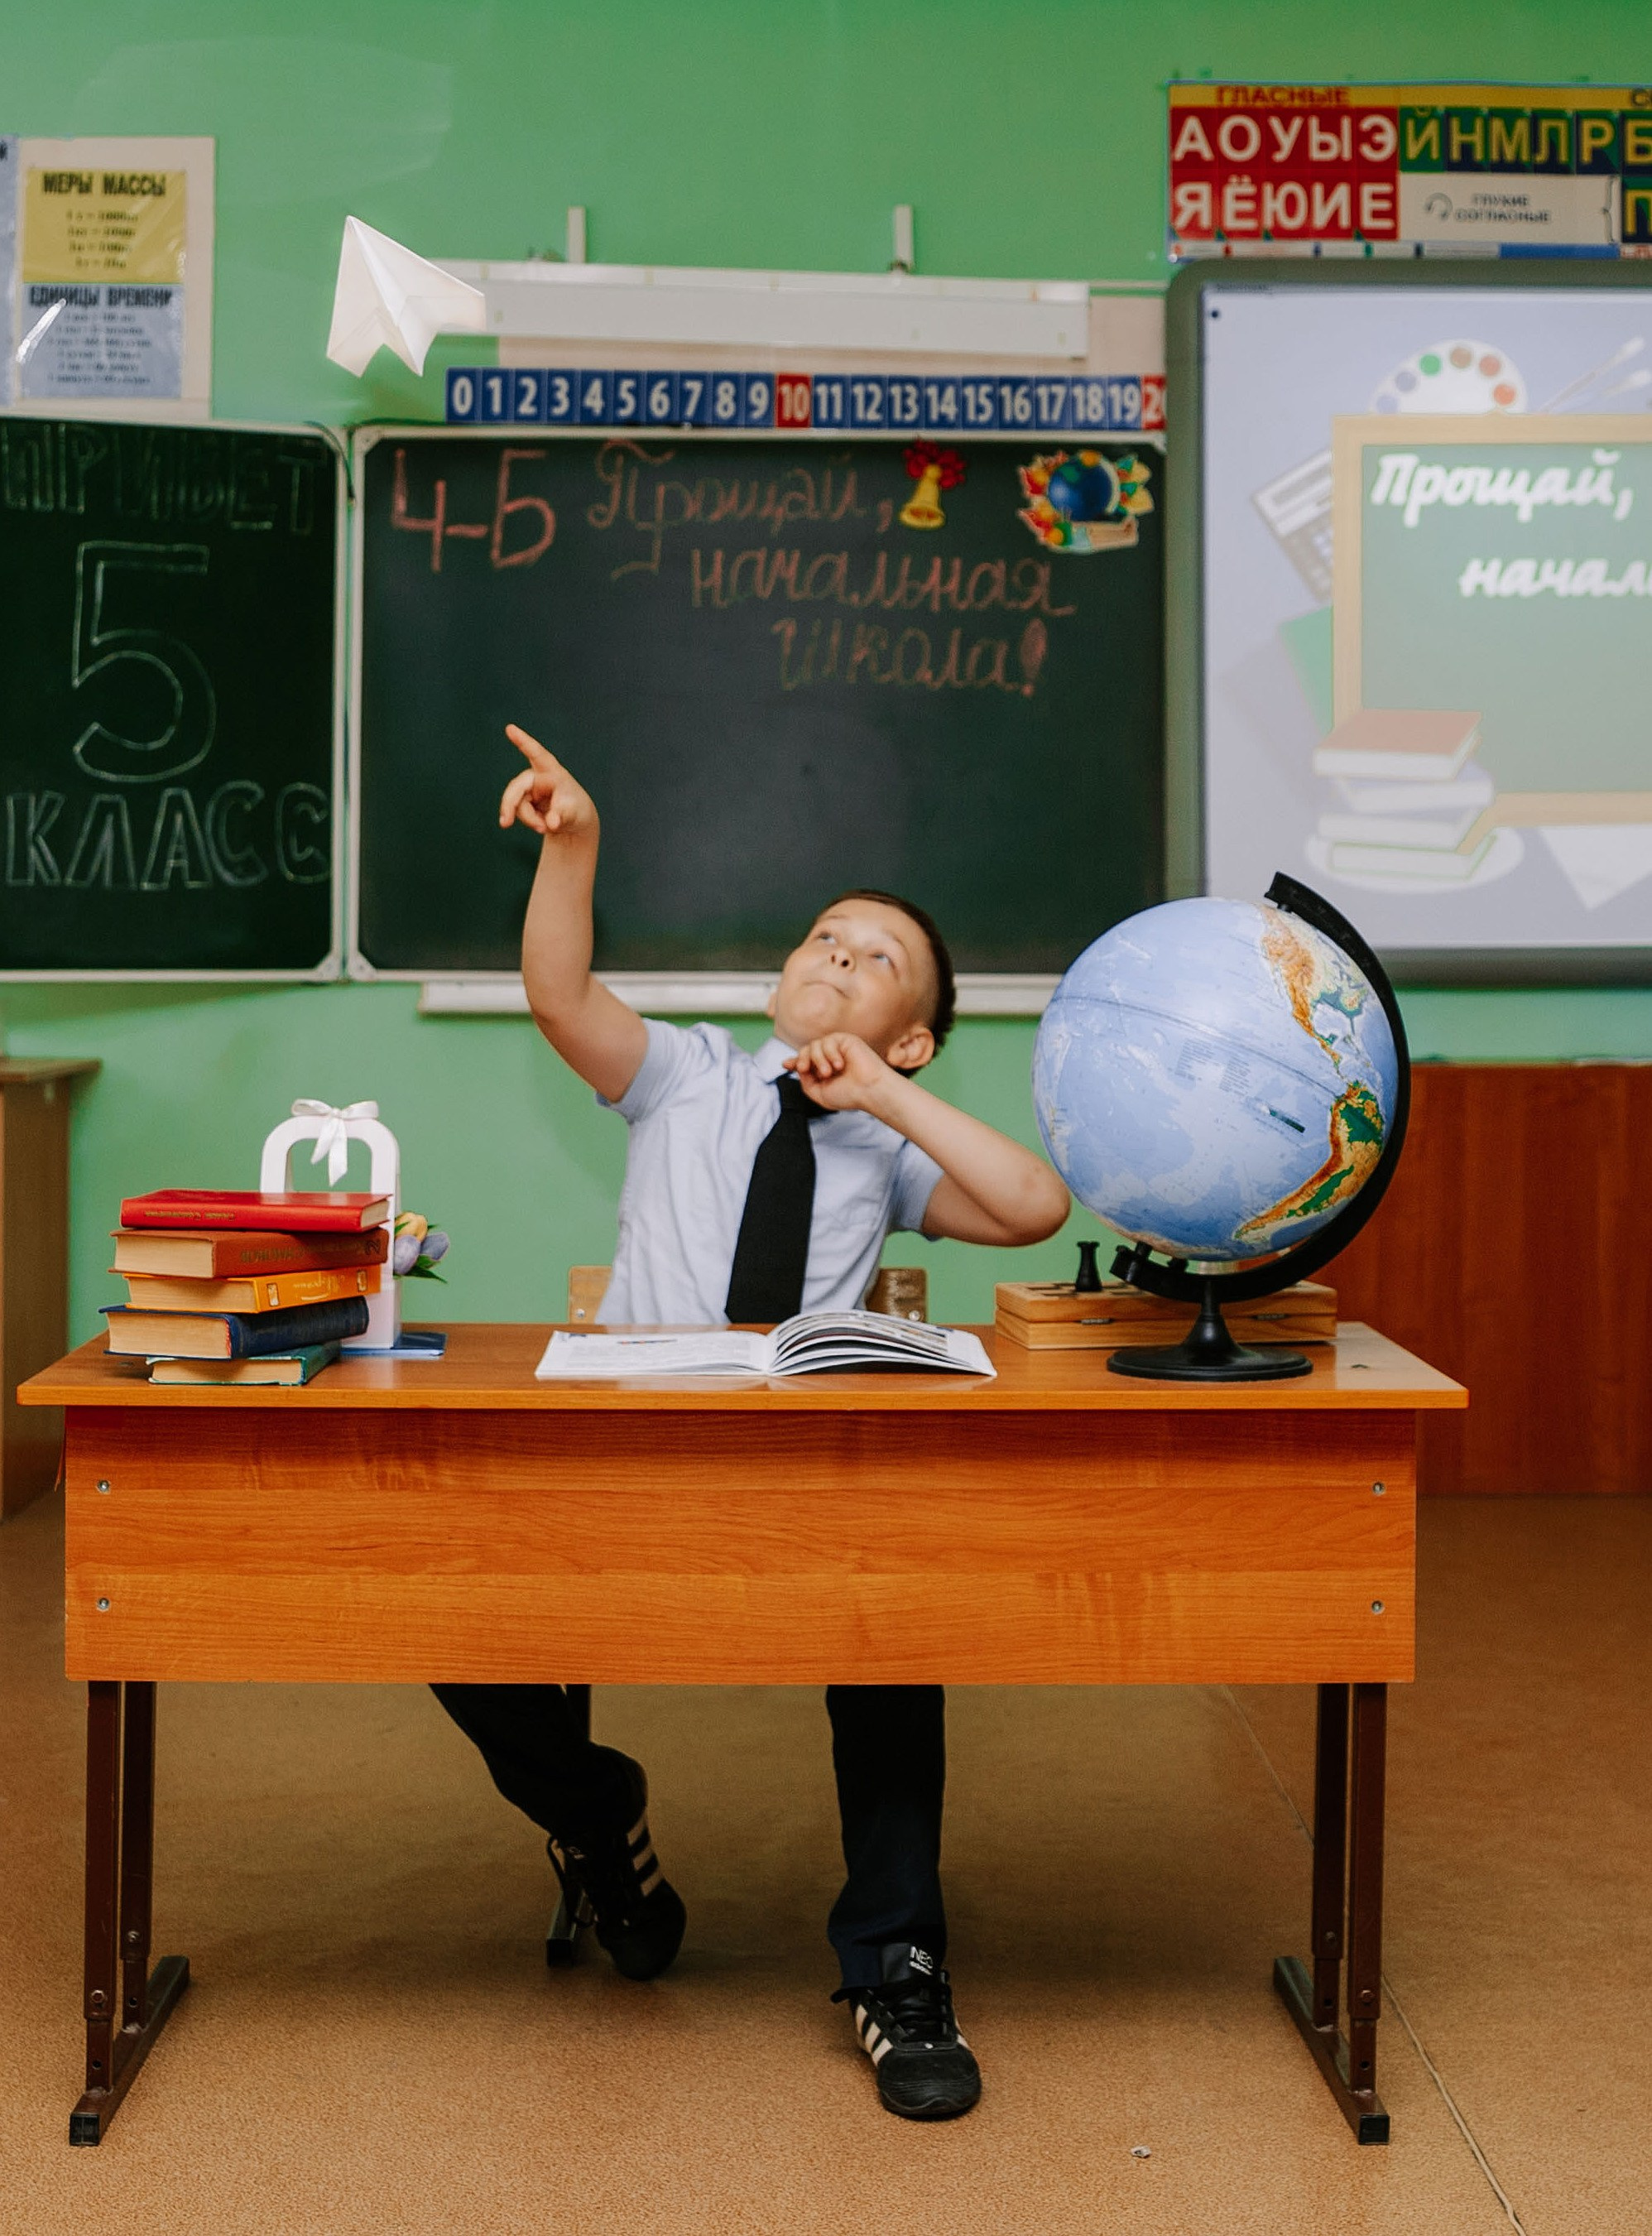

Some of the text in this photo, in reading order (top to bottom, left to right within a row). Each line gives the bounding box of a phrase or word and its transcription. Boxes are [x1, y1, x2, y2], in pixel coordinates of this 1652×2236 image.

[1216, 85, 1351, 104] ГЛАСНЫЕ
[1632, 89, 1652, 108] С
[43, 172, 166, 196] МЕРЫ МАССЫ
[453, 376, 1166, 423] 0 1 2 3 4 5 6 7 8 9 10 11 12 13 14 15 16 17 18 19 2
[391, 448, 557, 573] 4-Б
[1371, 448, 1634, 528] Прощай,
[690, 546, 1076, 618] начальная
[1459, 558, 1652, 597] начал
[72, 539, 217, 782] 5
[6, 780, 331, 892] КЛАСС
